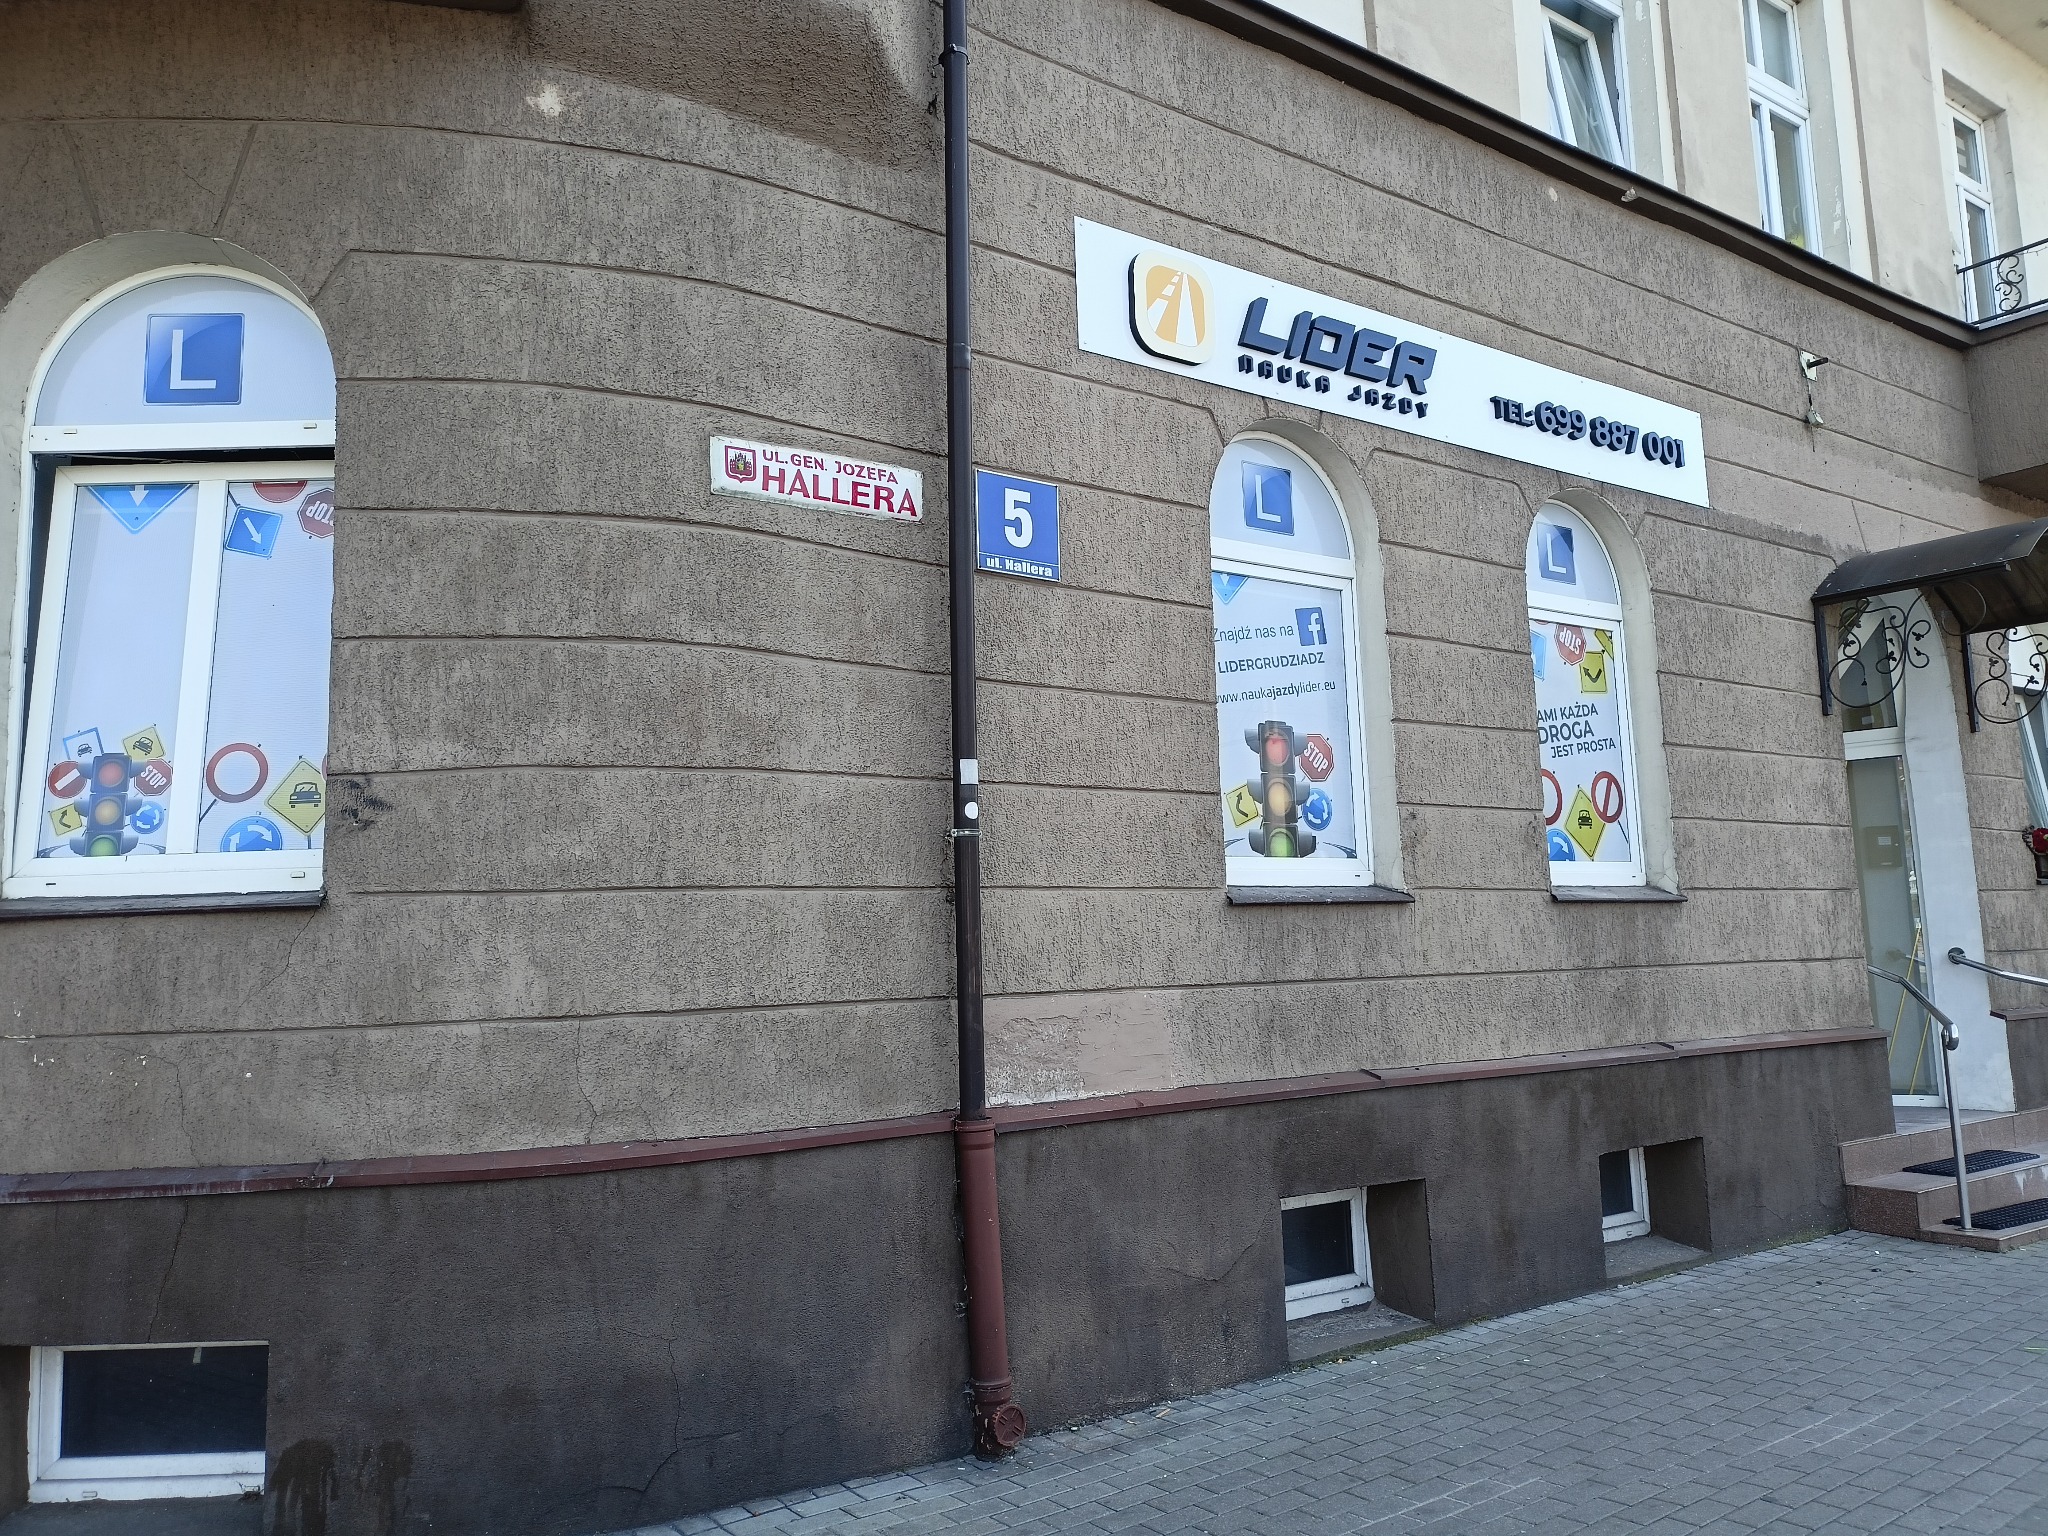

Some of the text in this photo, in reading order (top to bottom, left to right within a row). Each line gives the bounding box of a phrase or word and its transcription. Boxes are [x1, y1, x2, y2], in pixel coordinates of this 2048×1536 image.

[169, 329, 217, 390] L
[1237, 296, 1437, 395] LIDER
[1238, 354, 1429, 419] NAUKA JAZDY
[1535, 401, 1587, 440] 699
[1589, 416, 1639, 455] 887
[1642, 431, 1685, 468] 001
[761, 465, 918, 517] HALLERA
[1255, 474, 1282, 523] L
[305, 500, 334, 527] TOP
[1004, 487, 1033, 548] 5
[986, 557, 1053, 577] ul. Hallera
[1546, 533, 1567, 574] L
[1254, 626, 1276, 639] nas
[1279, 625, 1295, 637] na
[1559, 626, 1582, 655] STOP
[1217, 652, 1326, 674] LIDERGRUDZIADZ
[1559, 701, 1599, 720] KAŻDA
[1537, 720, 1595, 745] DROGA
[1550, 737, 1617, 758] JEST PROSTA
[1303, 741, 1329, 773] STOP
[140, 764, 167, 789] STOP
